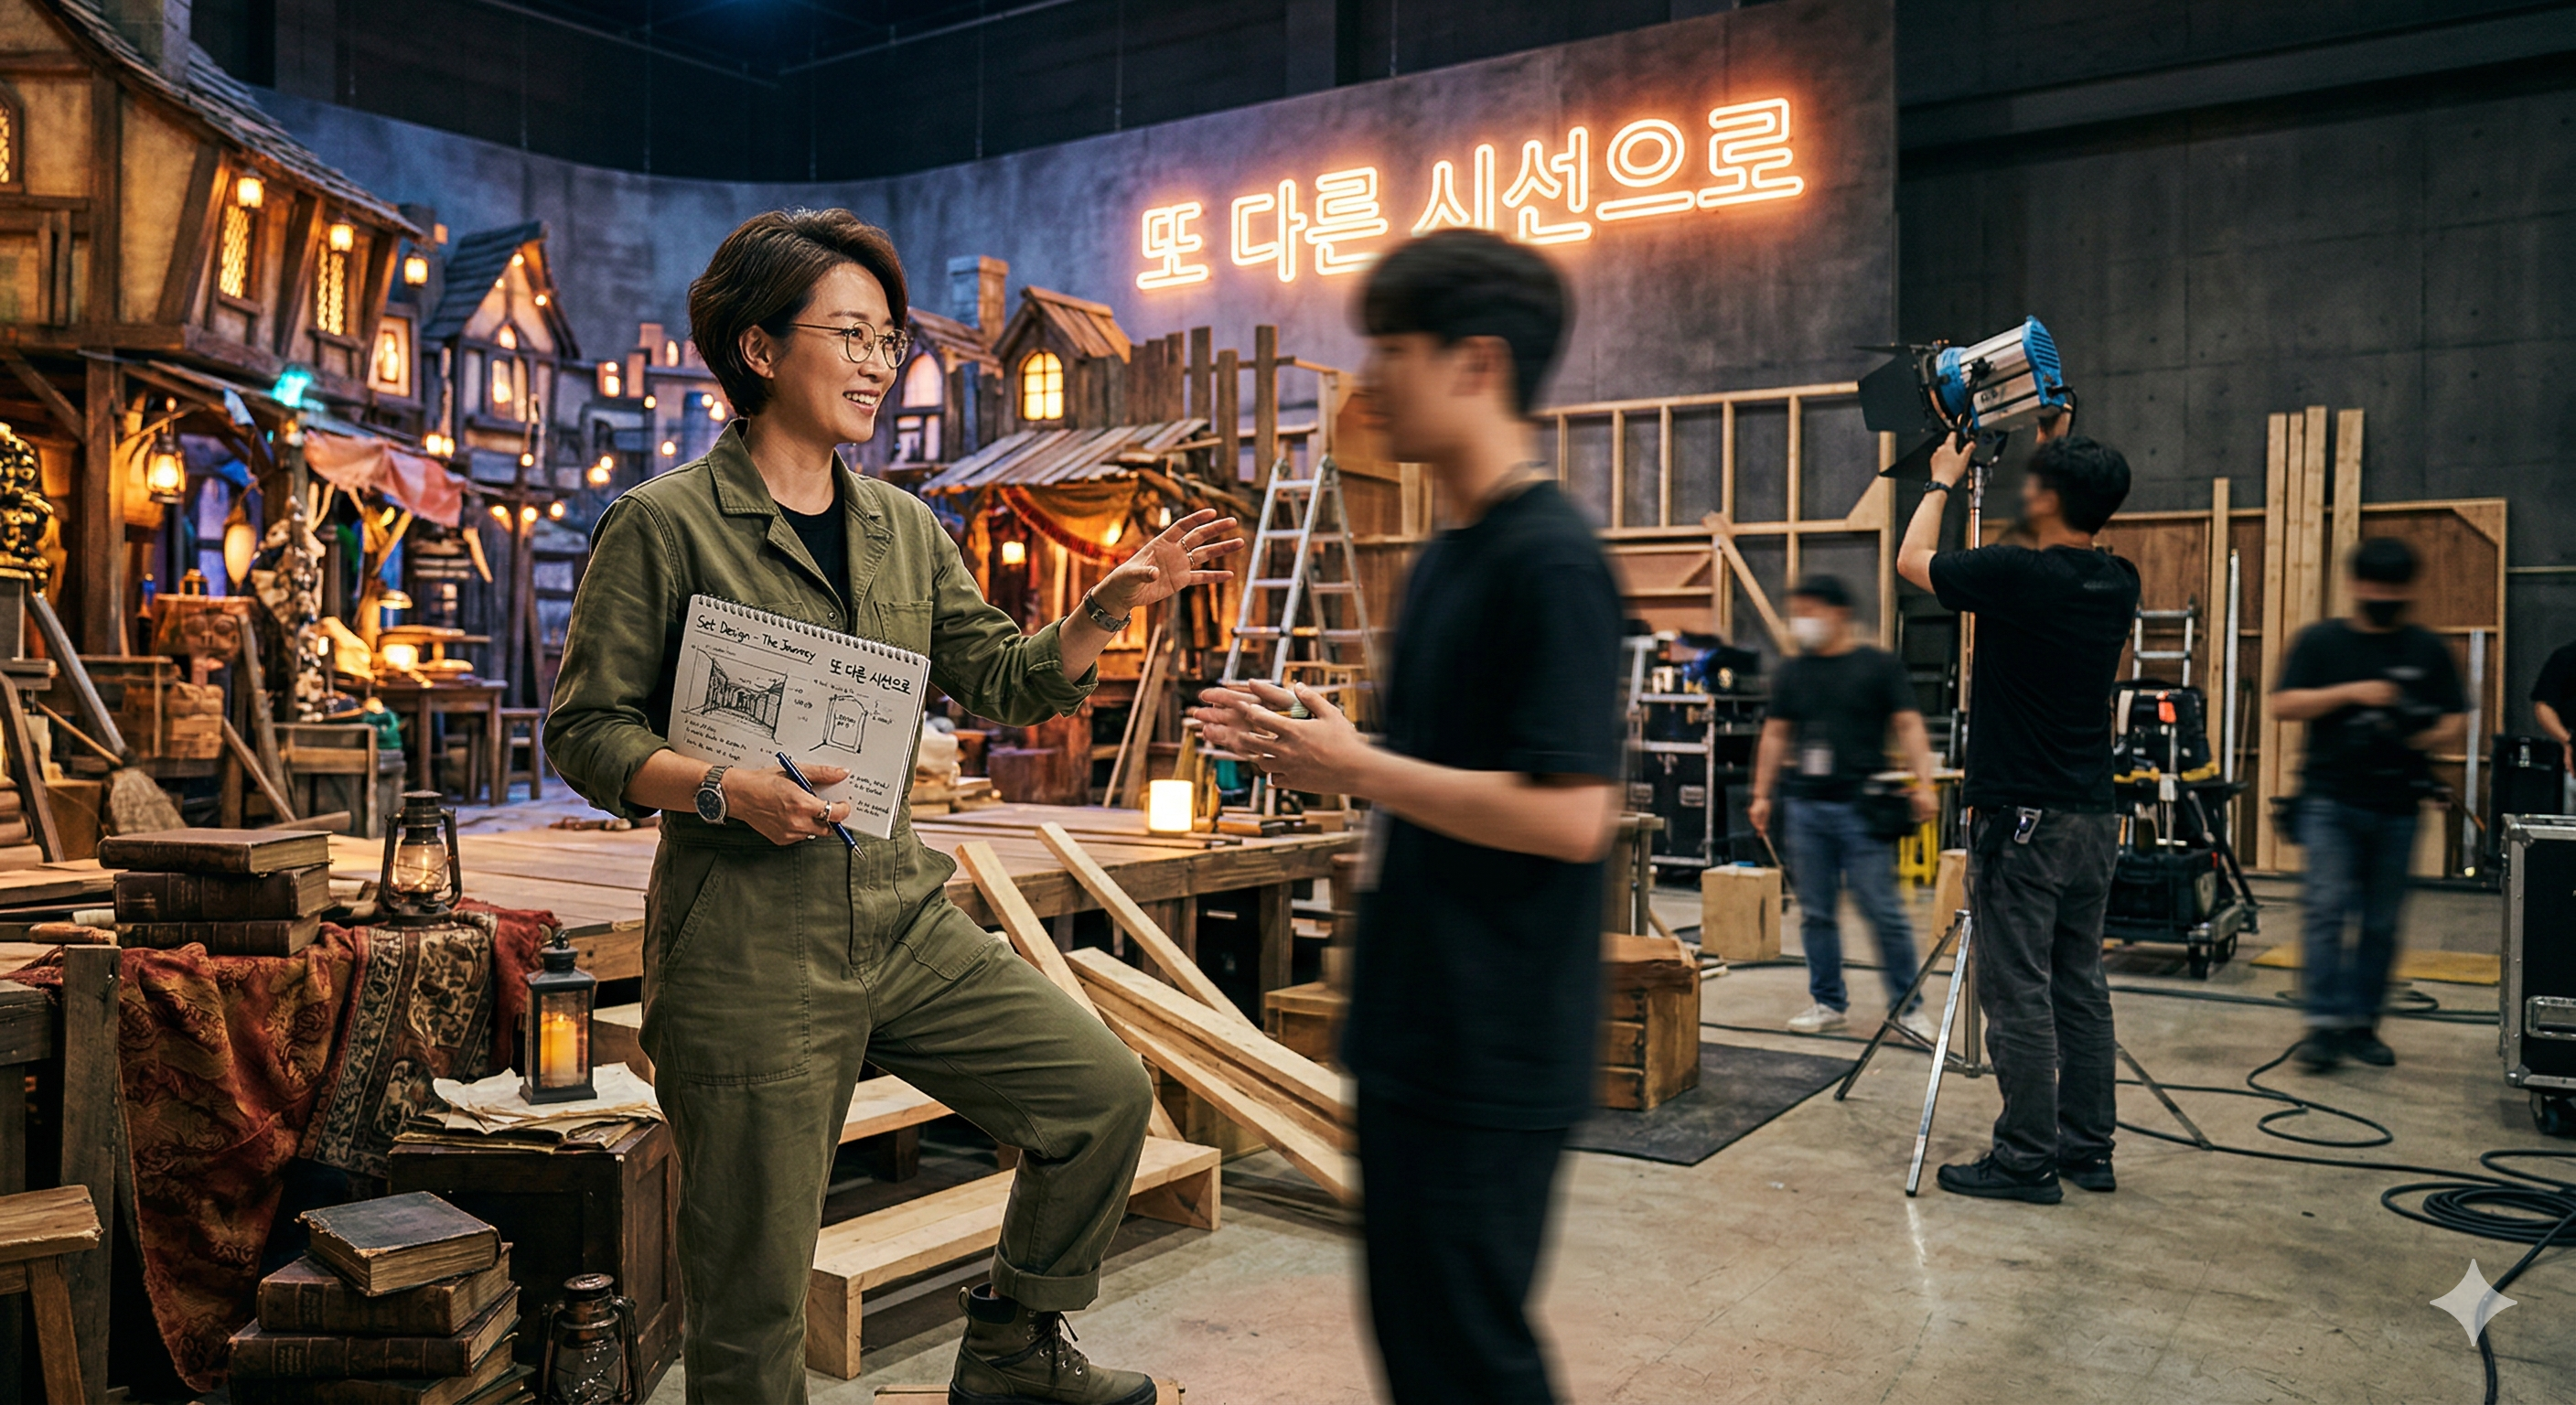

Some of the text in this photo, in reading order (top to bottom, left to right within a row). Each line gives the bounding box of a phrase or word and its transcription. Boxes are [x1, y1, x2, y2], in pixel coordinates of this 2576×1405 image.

[1135, 96, 1805, 290] 또 다른 시선으로
[696, 615, 716, 632] Set
[720, 621, 750, 643] Design
[762, 633, 778, 649] The
[830, 659, 843, 676] 또
[845, 664, 867, 685] 다른
[869, 671, 911, 695] 시선으로
